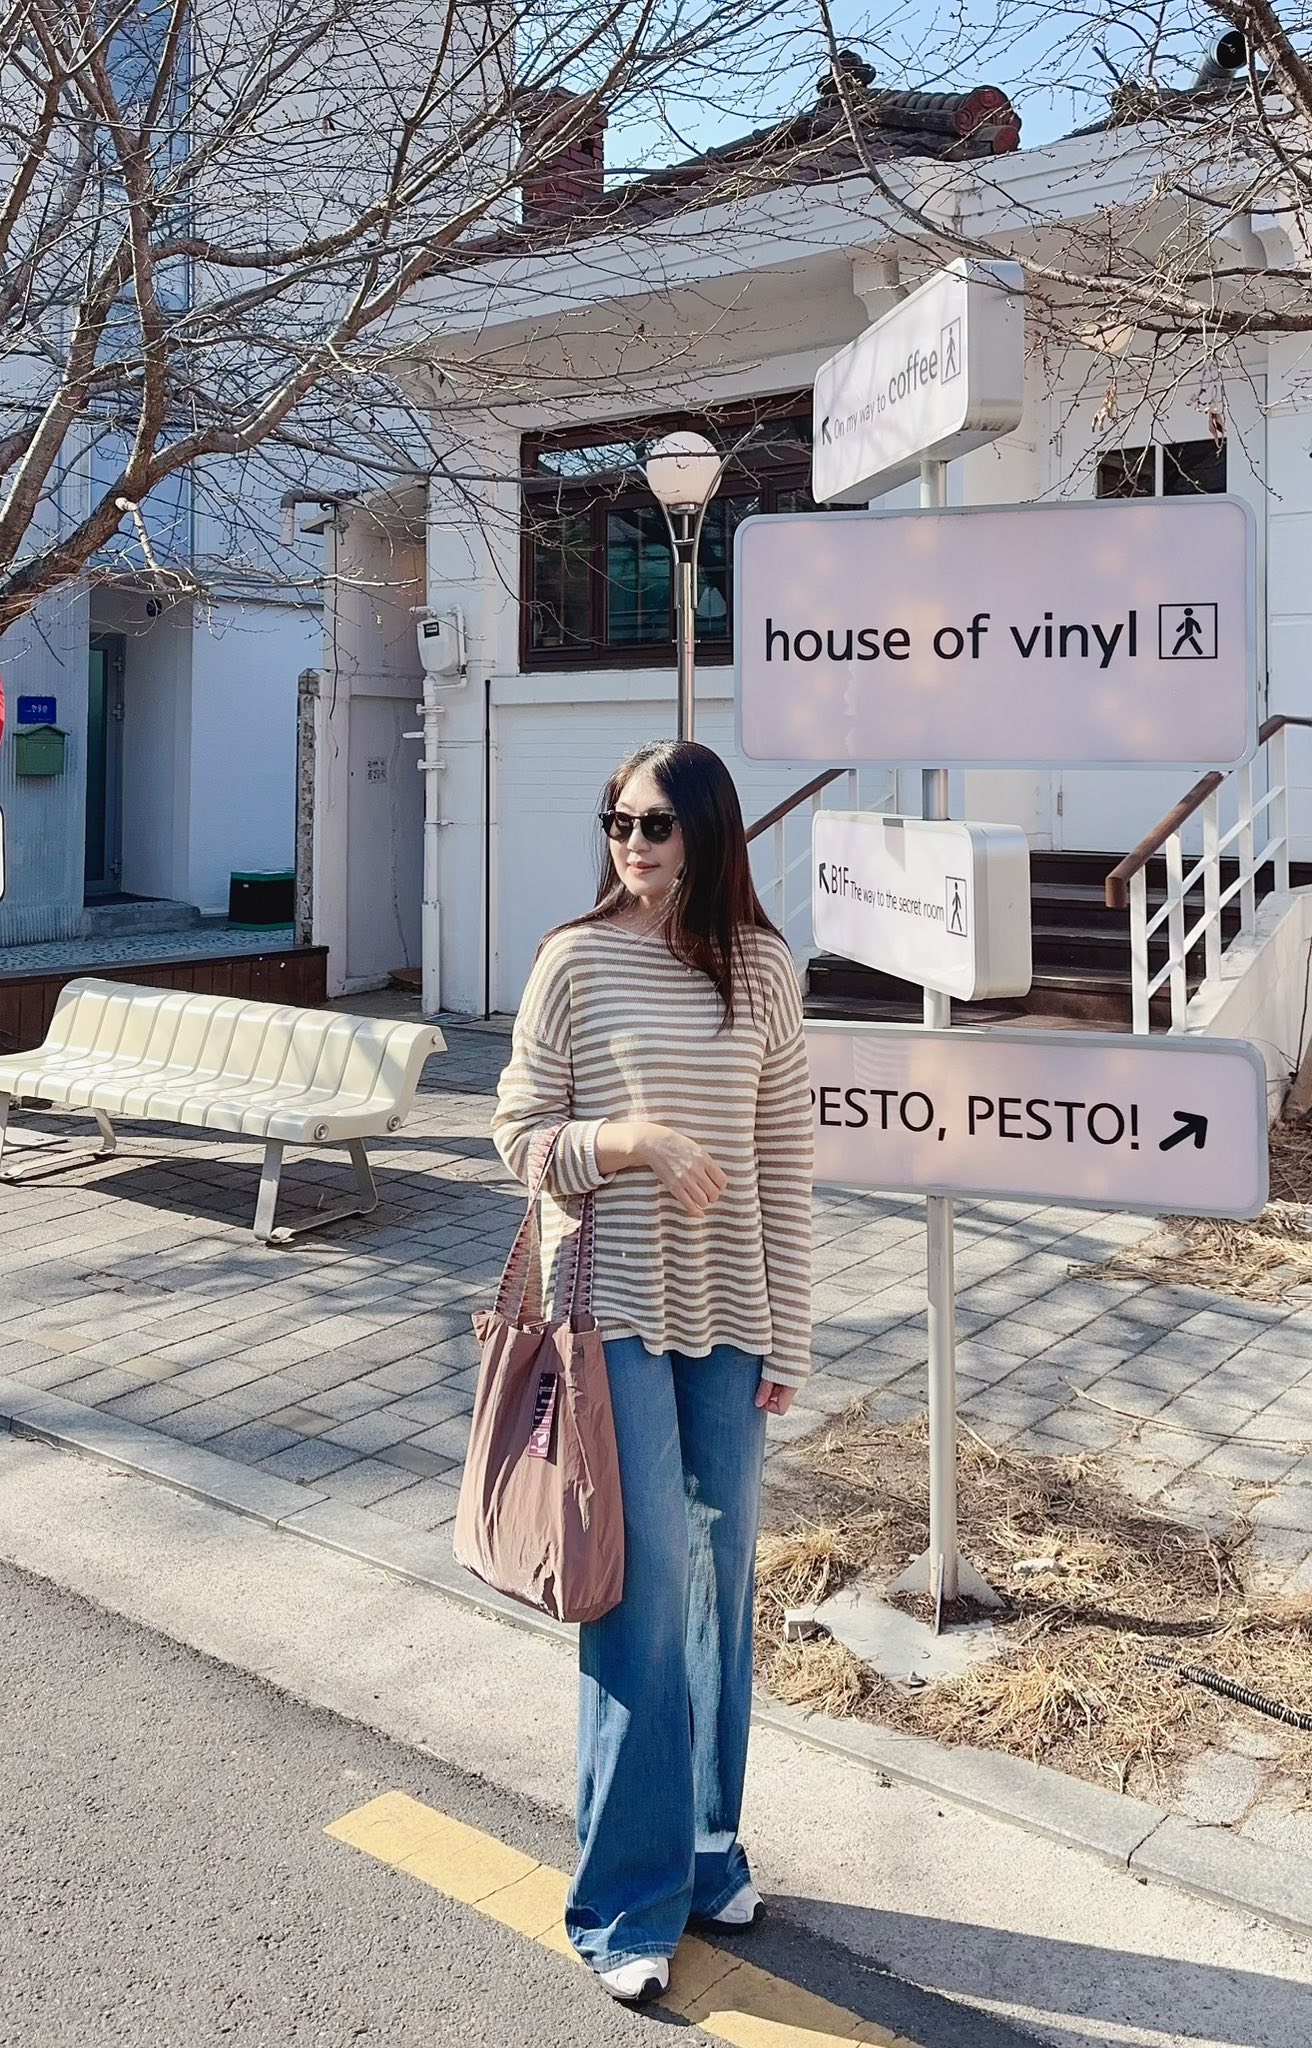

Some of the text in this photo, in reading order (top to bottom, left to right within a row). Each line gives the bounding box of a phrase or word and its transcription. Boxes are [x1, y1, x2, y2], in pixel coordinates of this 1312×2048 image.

[833, 349, 938, 439] On my way to coffee
[764, 610, 1138, 668] house of vinyl
[831, 865, 945, 921] B1F The way to the secret room
[810, 1086, 1140, 1151] ESTO, PESTO!
